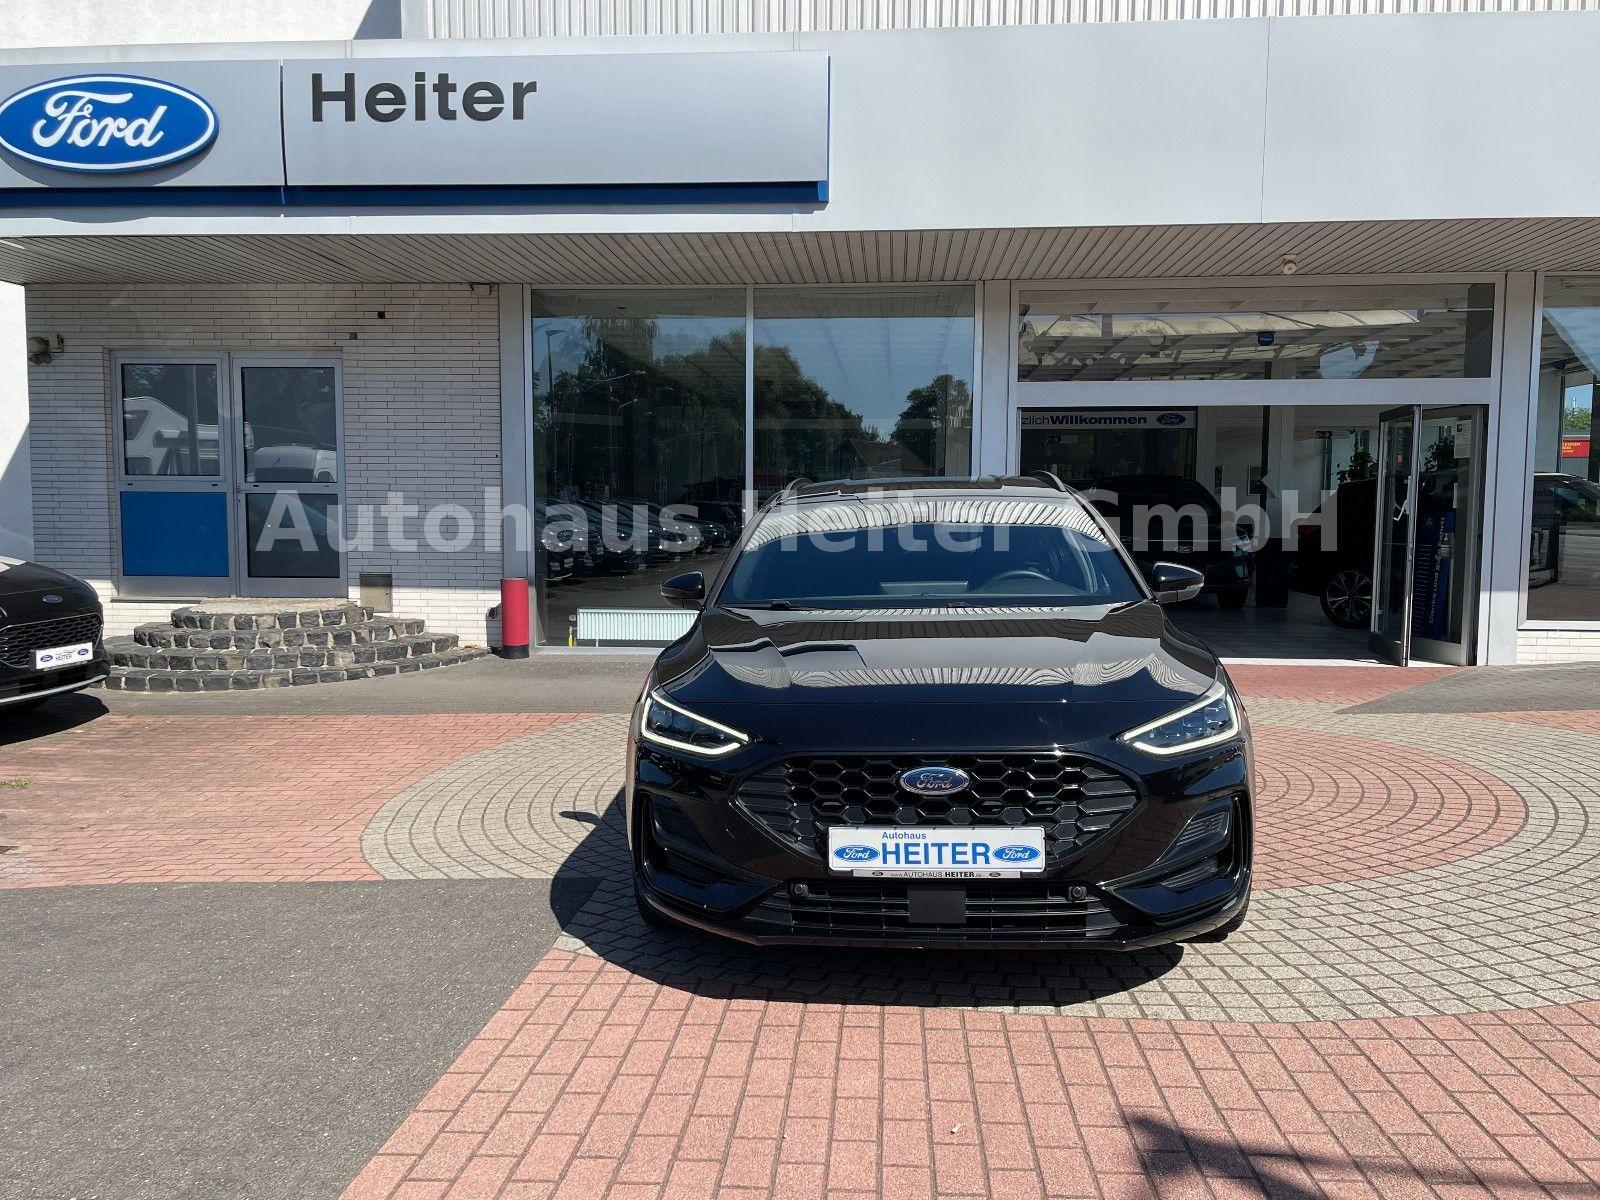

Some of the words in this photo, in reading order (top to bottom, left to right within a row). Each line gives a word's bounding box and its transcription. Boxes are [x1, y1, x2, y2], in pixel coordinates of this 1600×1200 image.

[312, 72, 537, 122] Heiter
[32, 90, 168, 149] Ford
[1021, 414, 1147, 425] zlichWillkommen
[916, 772, 952, 789] Ford
[882, 831, 927, 840] Autohaus
[843, 847, 870, 860] Ford
[882, 842, 991, 865] HEITER
[1002, 847, 1031, 860] Ford
